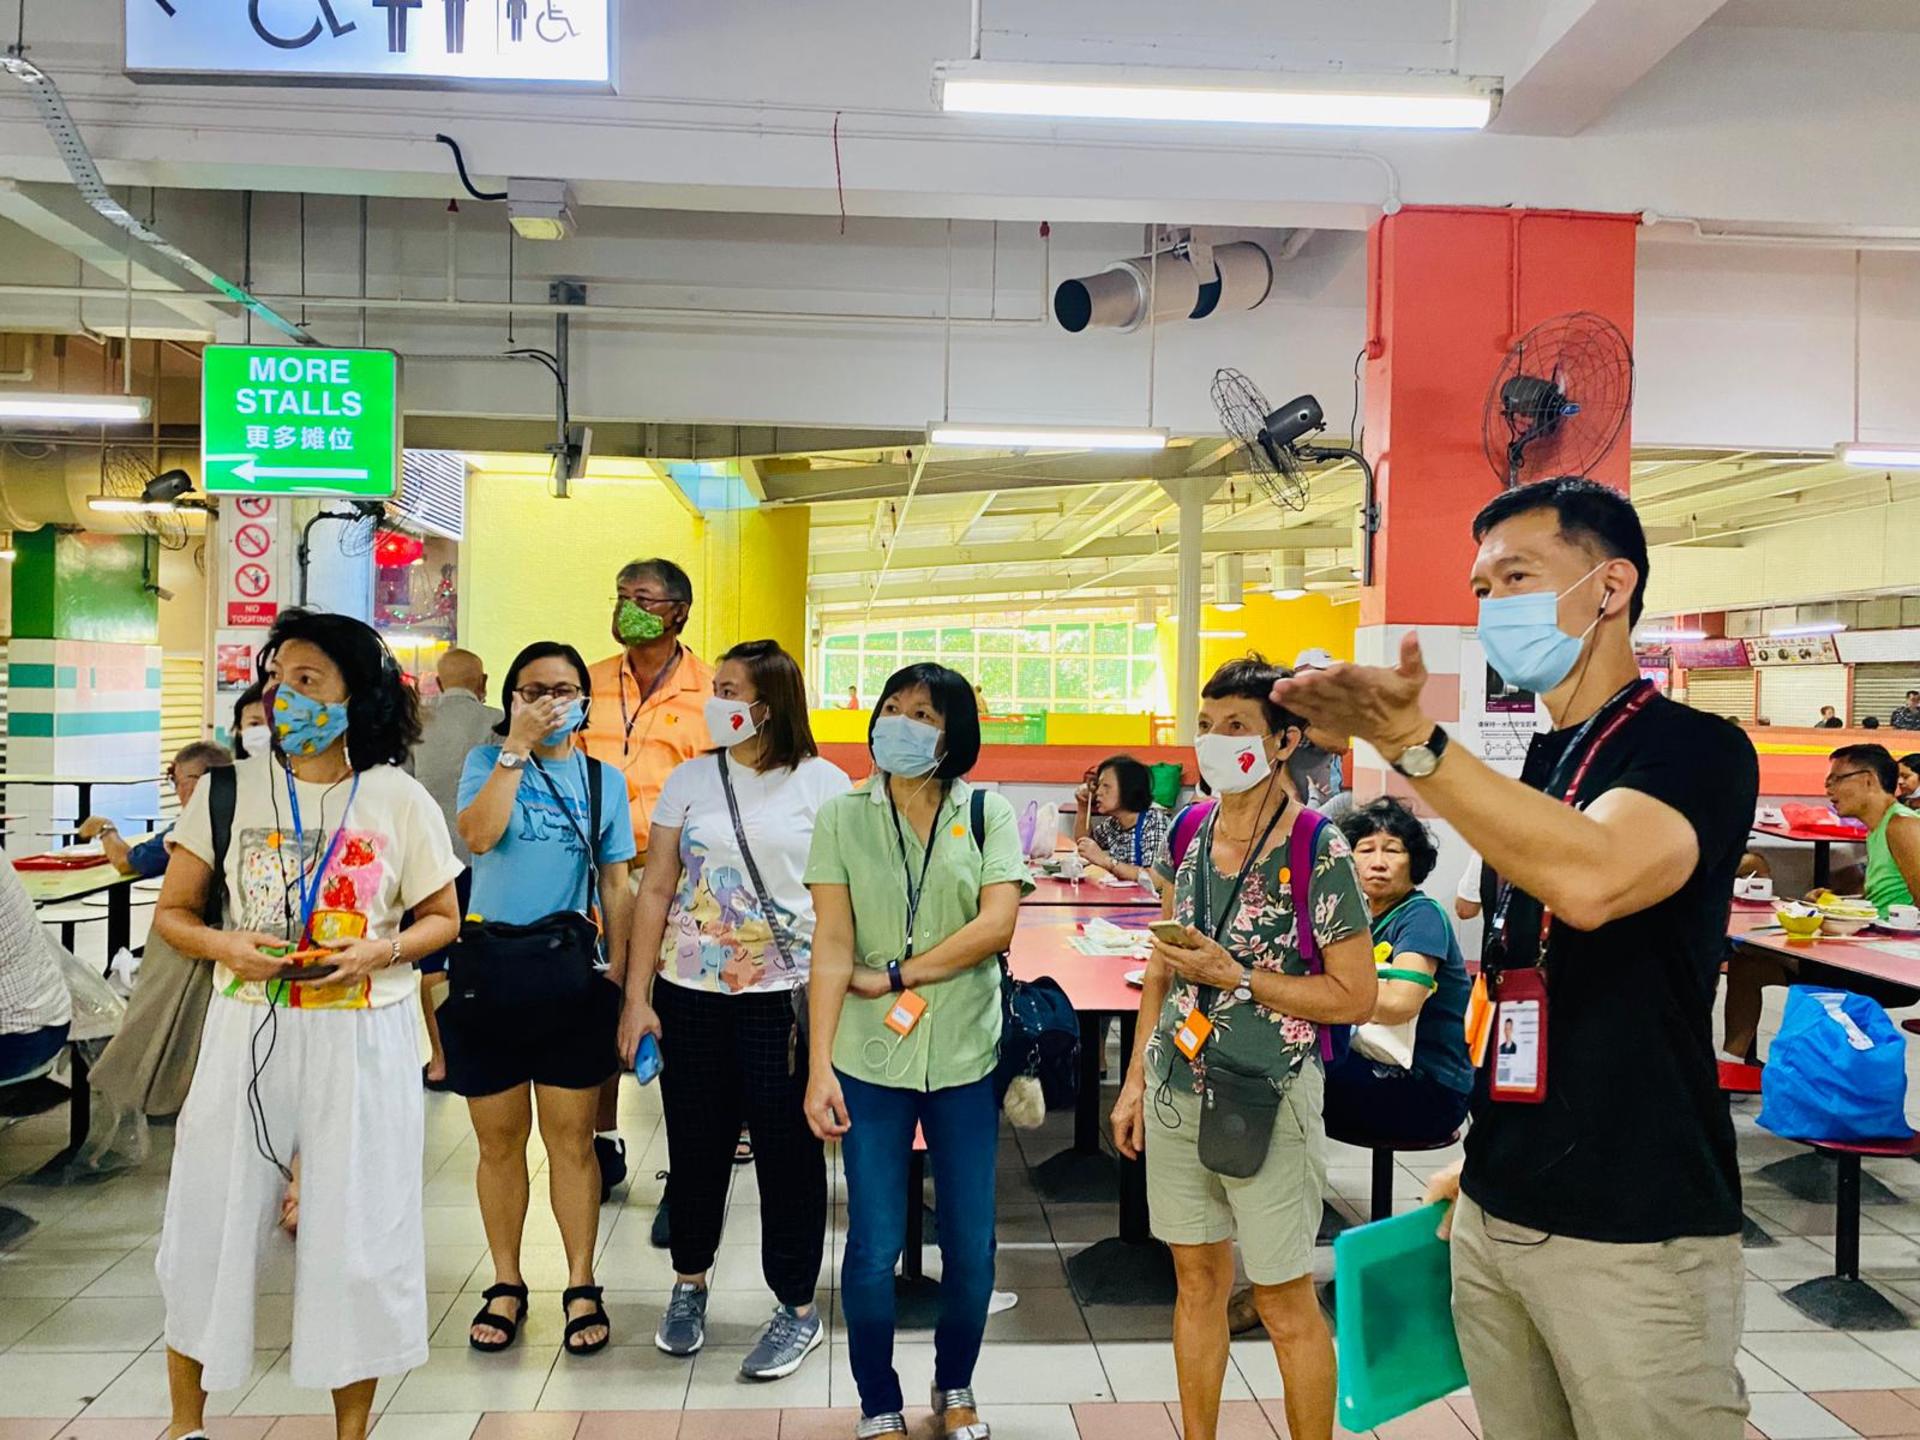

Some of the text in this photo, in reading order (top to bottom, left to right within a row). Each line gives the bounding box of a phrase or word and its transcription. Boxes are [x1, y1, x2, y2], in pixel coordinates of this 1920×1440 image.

[249, 357, 350, 384] MORE
[236, 388, 363, 417] STALLS
[244, 604, 261, 614] NO
[231, 614, 274, 624] TOUTING
